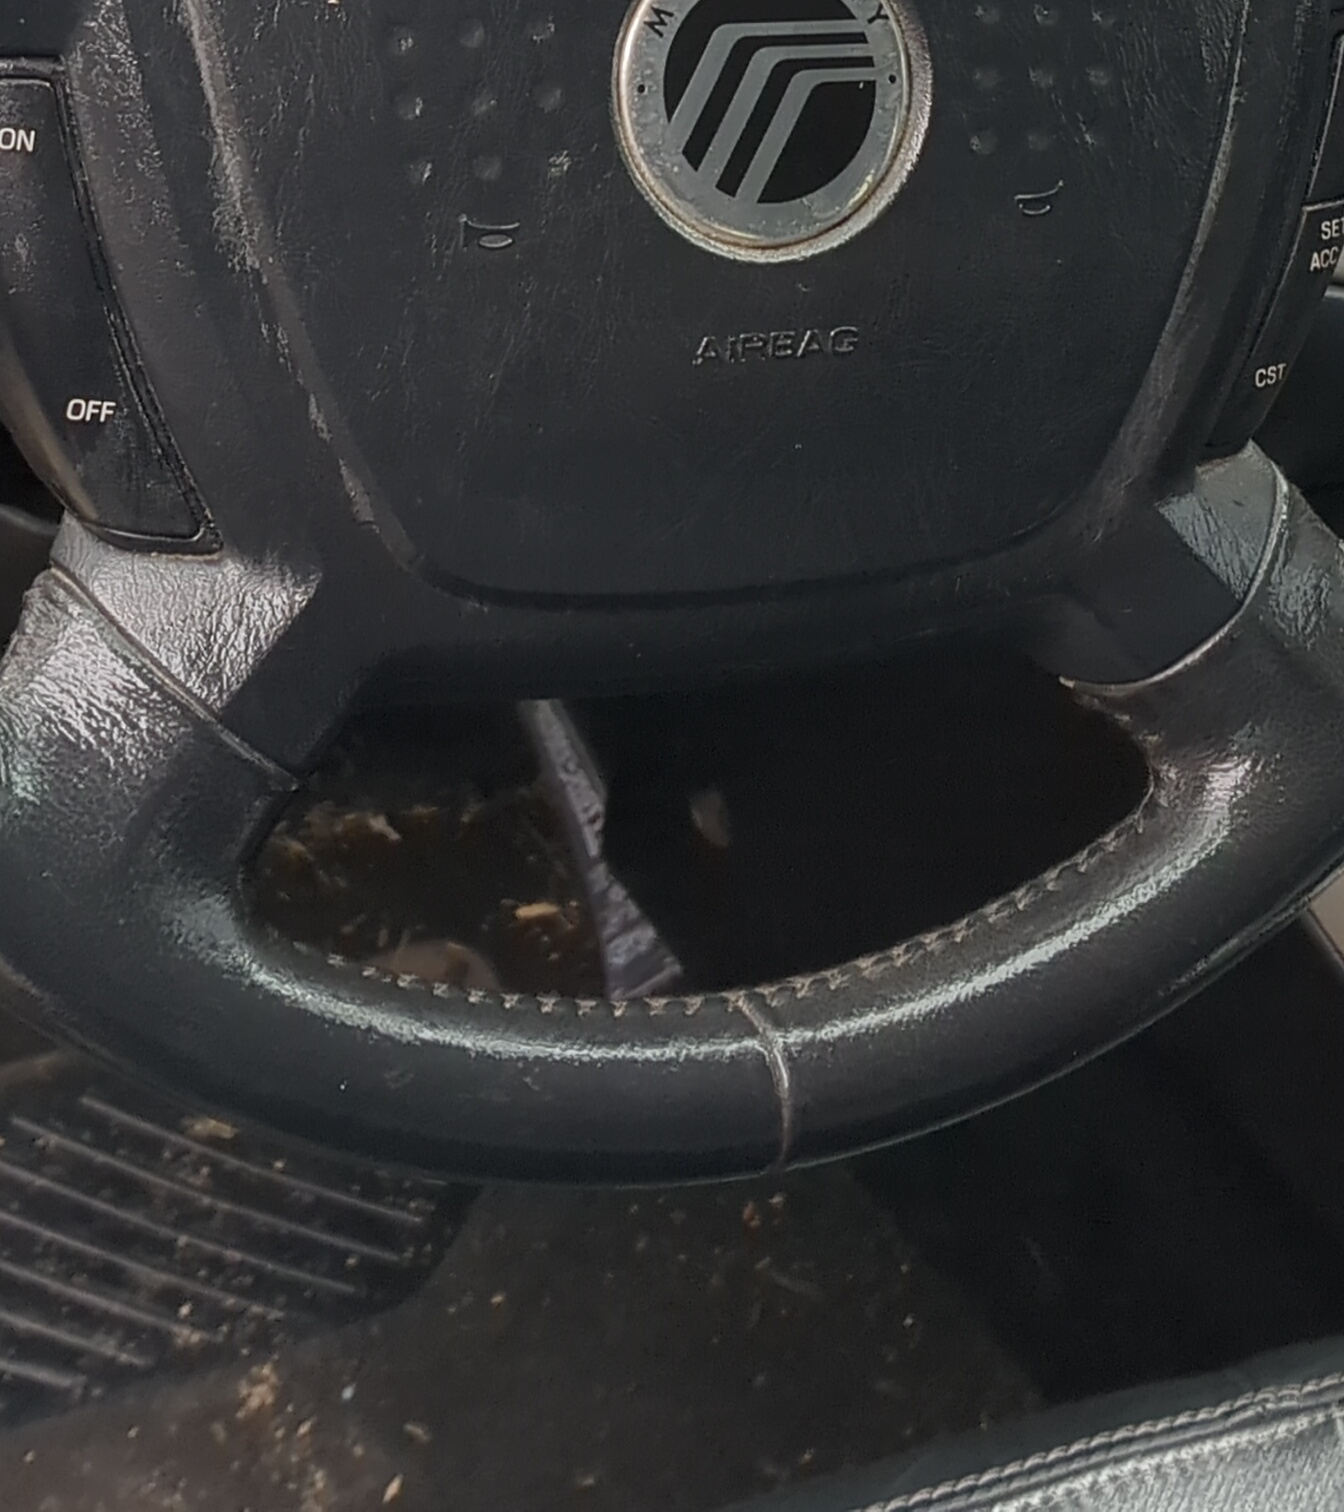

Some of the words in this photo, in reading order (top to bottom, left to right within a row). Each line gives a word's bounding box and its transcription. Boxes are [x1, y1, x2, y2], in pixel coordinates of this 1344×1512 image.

[693, 326, 860, 364] AIRBAG
[1255, 363, 1286, 388] CST
[66, 399, 116, 423] OFF
